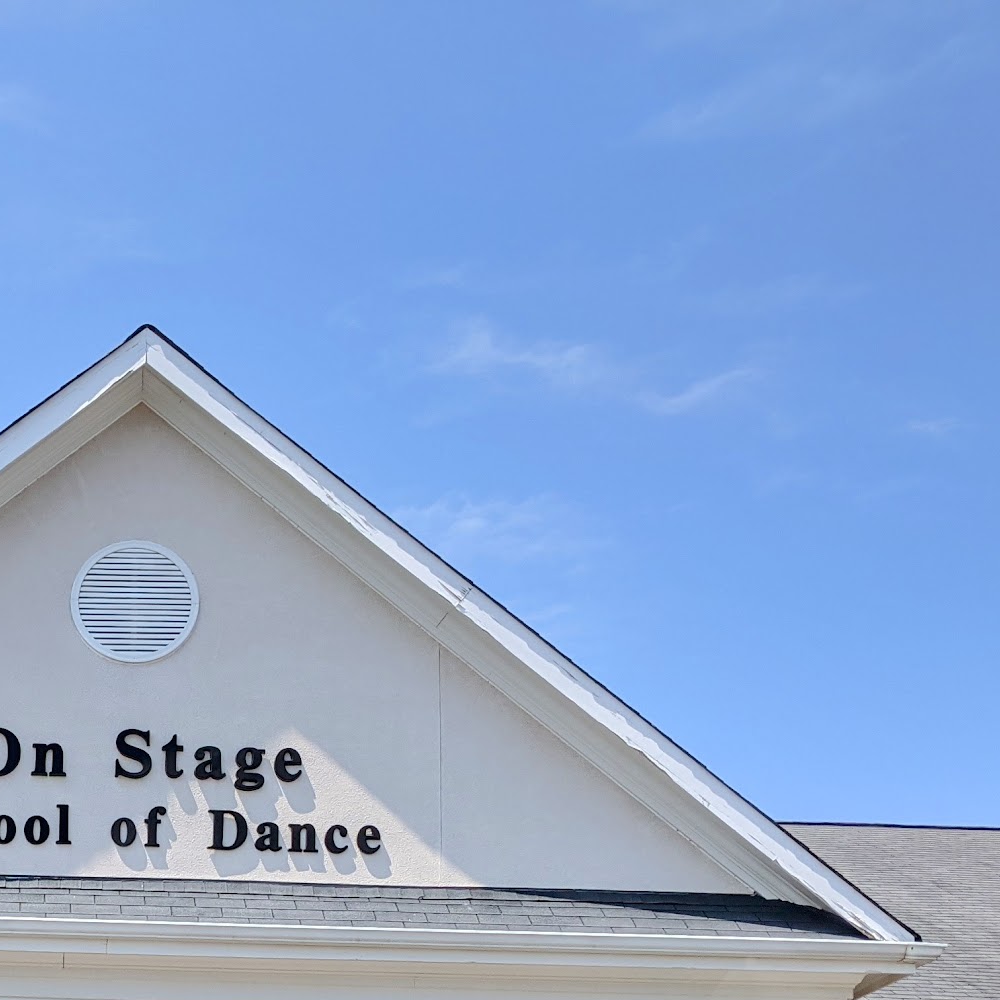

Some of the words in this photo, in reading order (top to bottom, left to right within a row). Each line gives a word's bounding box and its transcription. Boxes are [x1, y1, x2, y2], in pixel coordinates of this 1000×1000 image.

[115, 729, 302, 791] Stage
[111, 806, 166, 847] of
[207, 810, 380, 854] Dance
